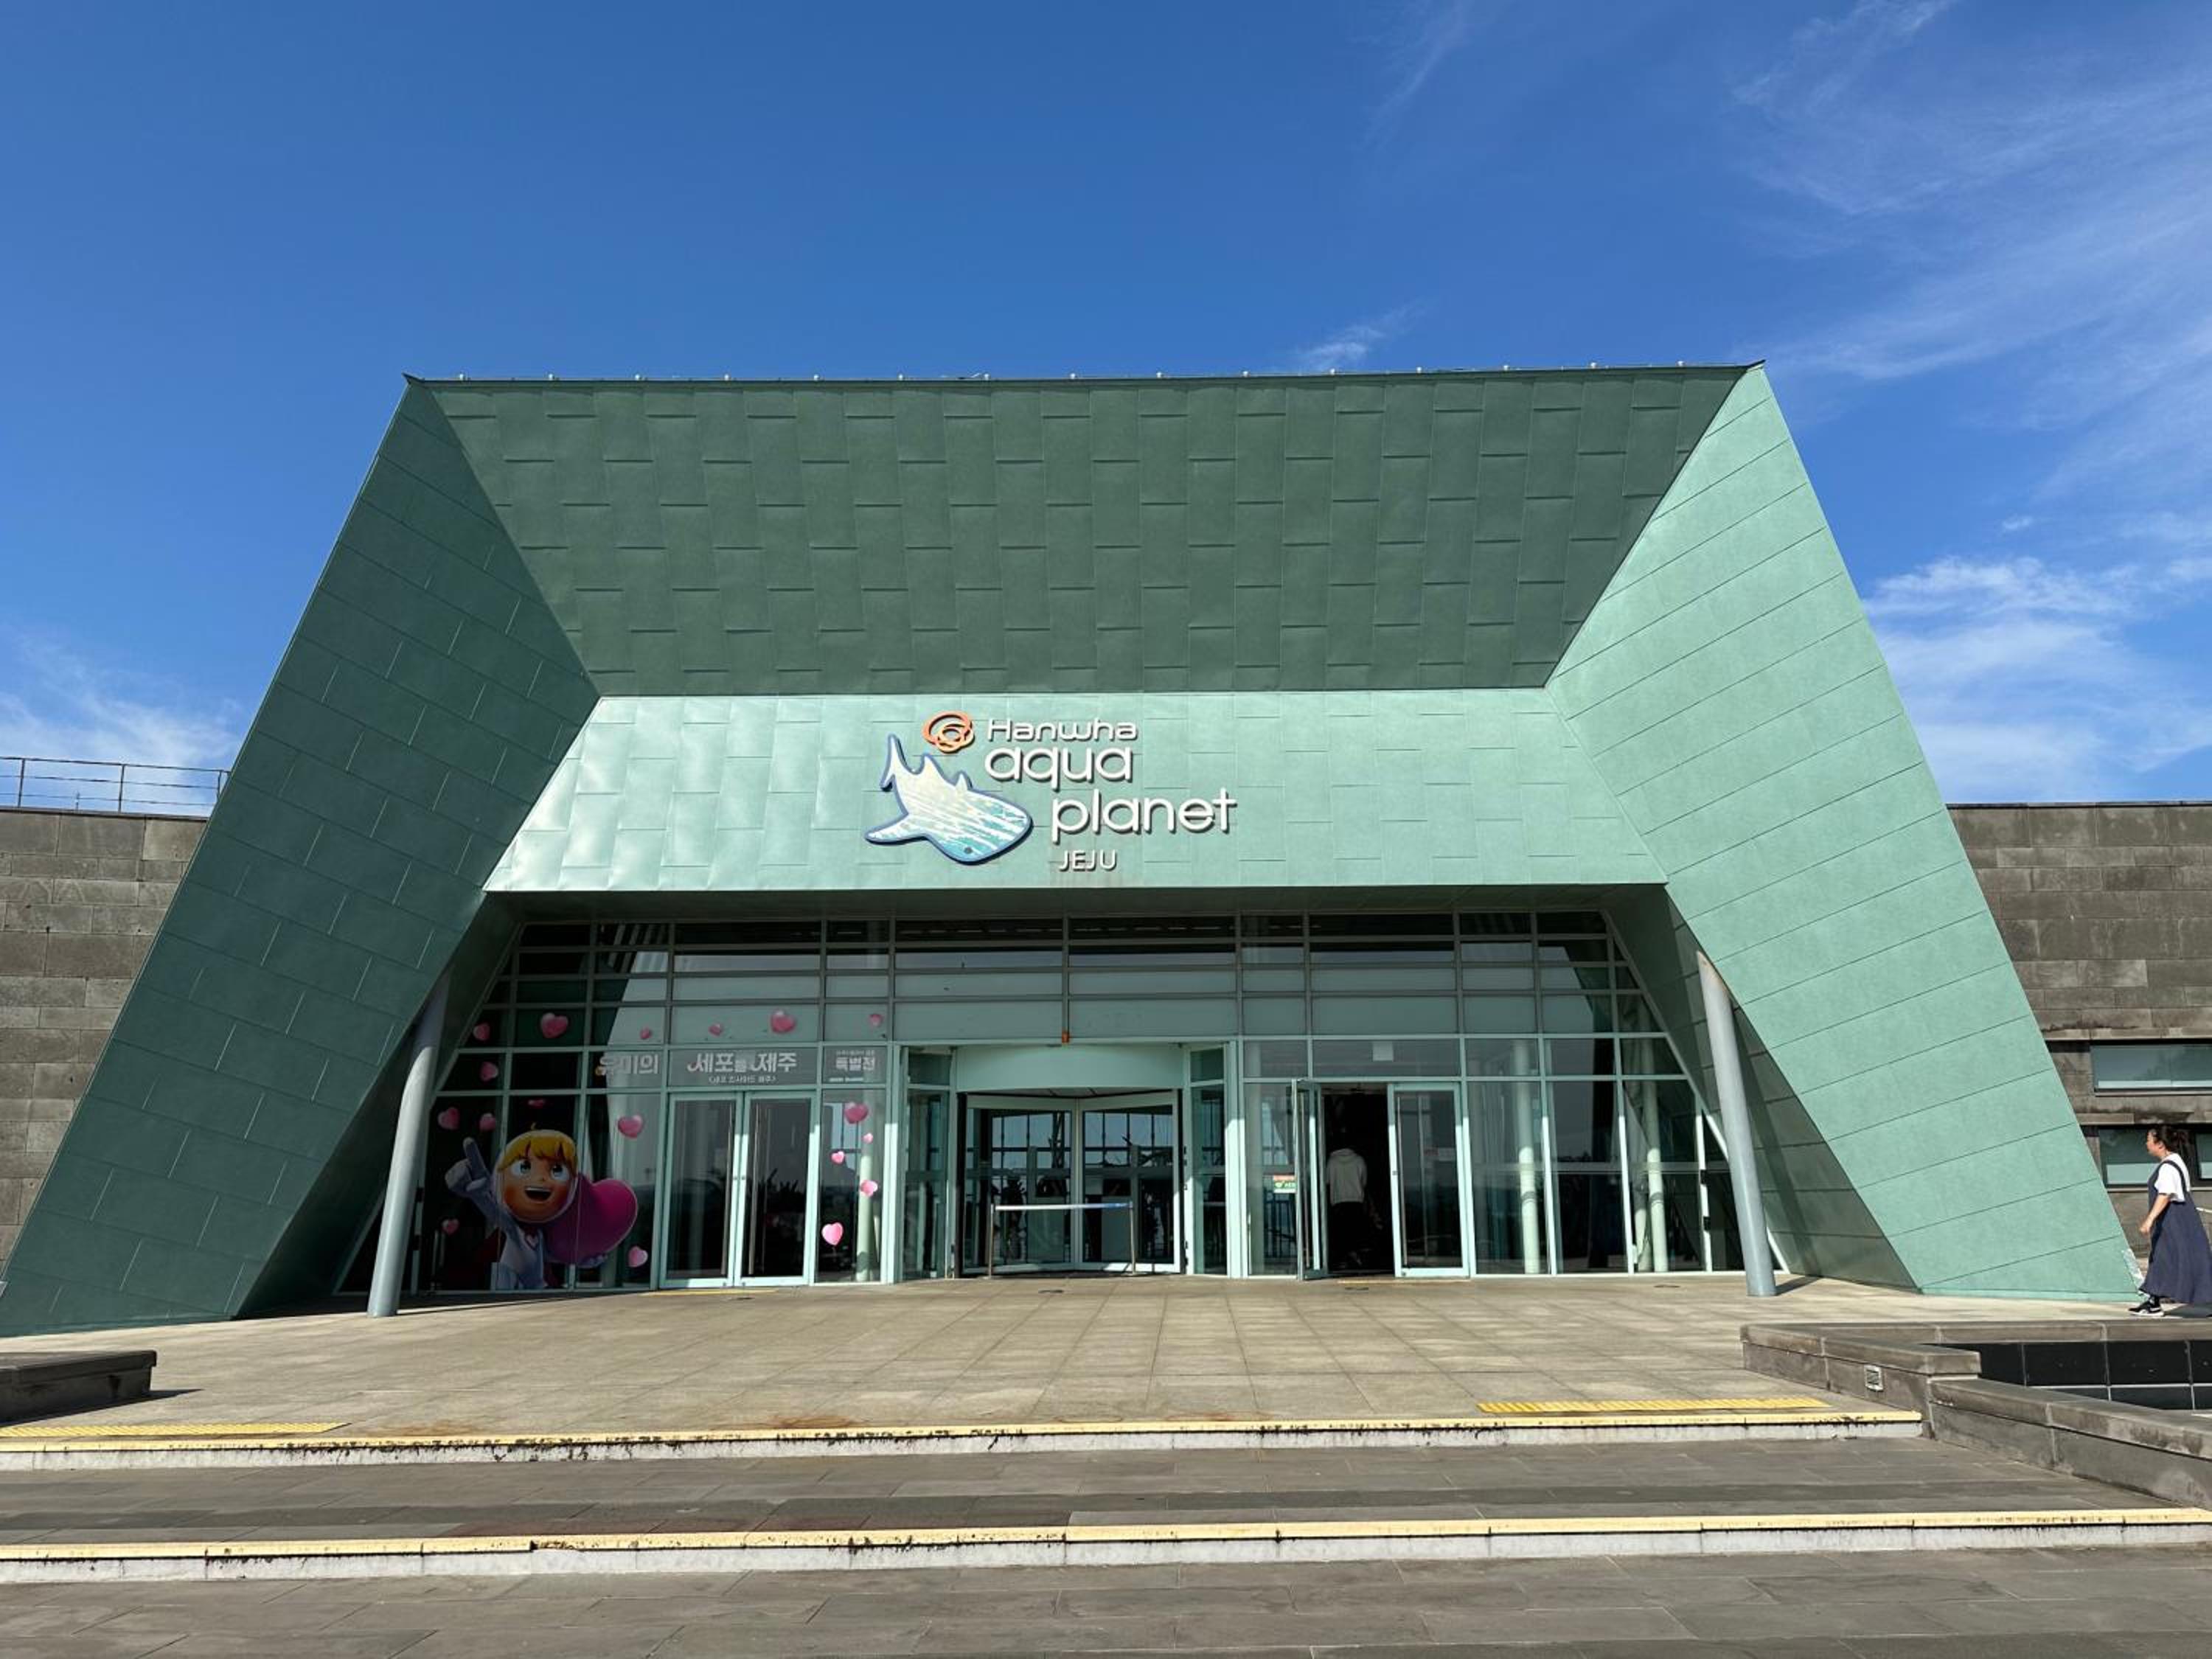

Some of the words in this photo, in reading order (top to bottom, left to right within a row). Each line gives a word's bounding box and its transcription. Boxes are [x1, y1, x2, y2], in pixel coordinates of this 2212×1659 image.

[987, 717, 1138, 741] Hanwha
[985, 745, 1133, 790] aqua
[1051, 787, 1237, 843] planet
[1058, 849, 1117, 872] JEJU
[750, 1052, 797, 1072] 제주
